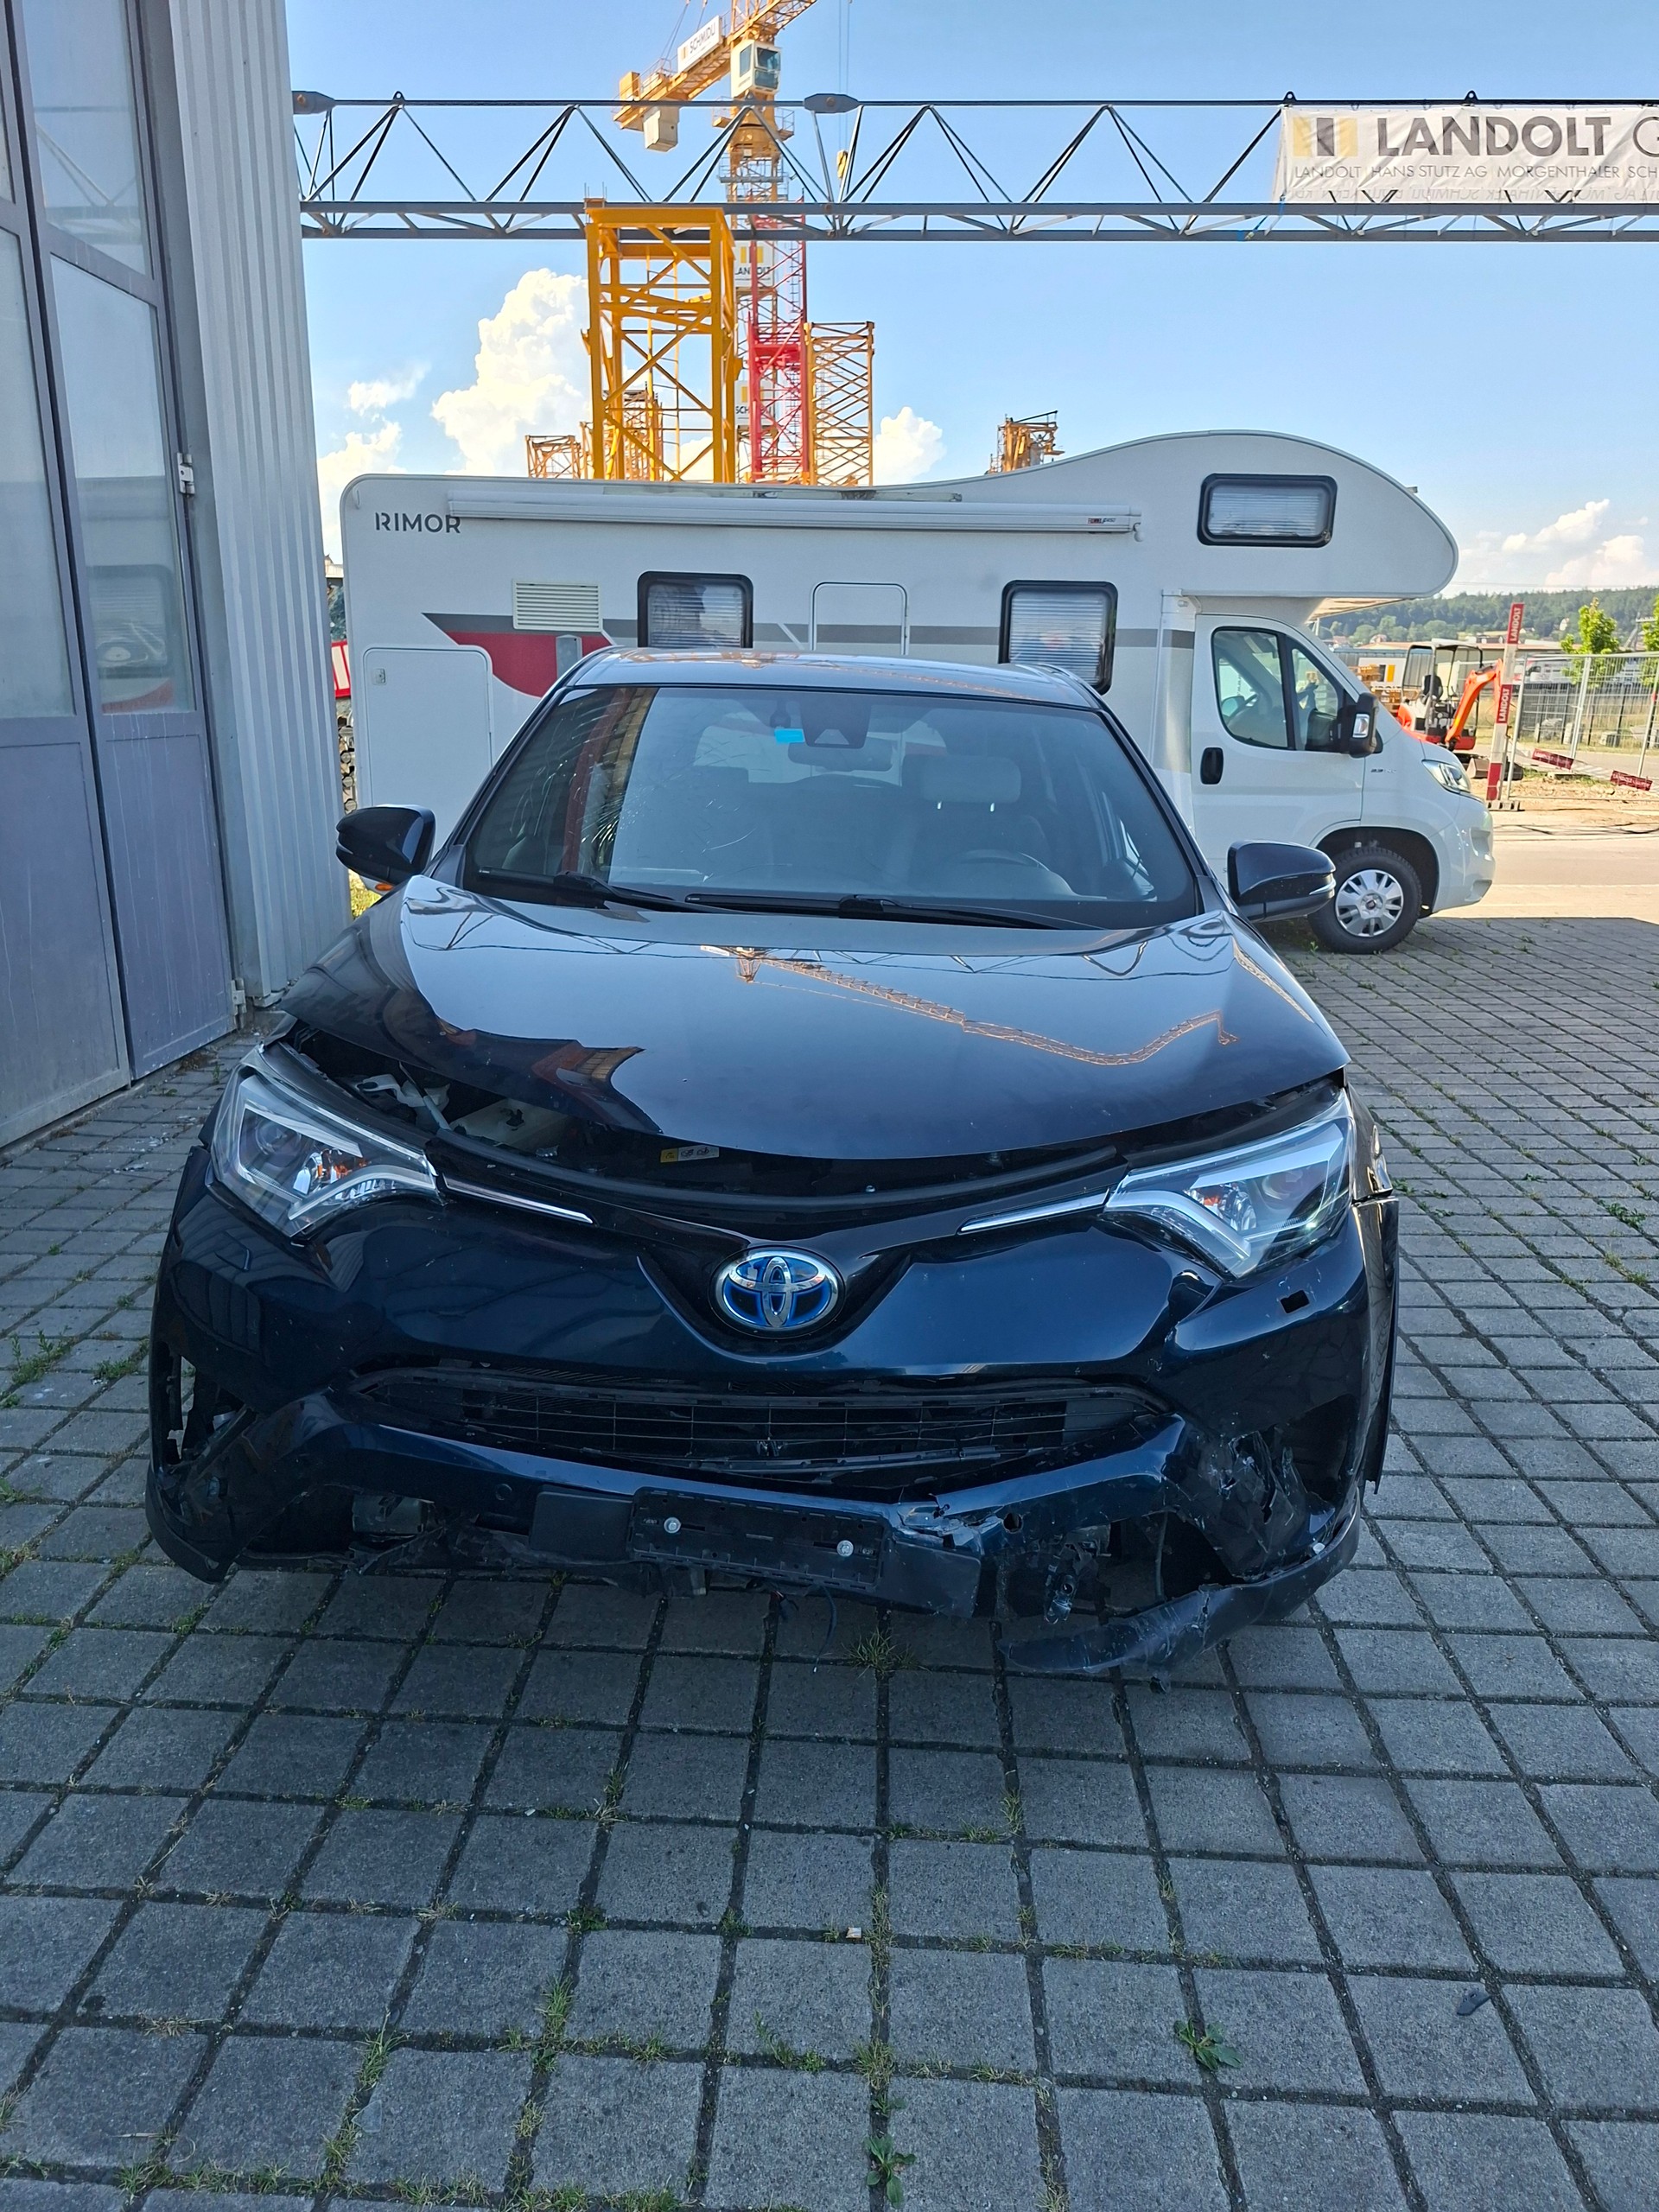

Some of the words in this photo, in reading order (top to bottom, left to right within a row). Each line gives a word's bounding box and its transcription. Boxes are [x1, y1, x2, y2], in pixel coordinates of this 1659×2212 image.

[1376, 115, 1611, 156] LANDOLT
[1294, 165, 1362, 178] LANDOLT
[1371, 165, 1414, 178] HANS
[1418, 165, 1460, 178] STUTZ
[1464, 165, 1487, 178] AG
[1497, 165, 1620, 178] MORGENTHALER
[375, 512, 461, 533] RIMOR
[1510, 607, 1522, 642] LANDOLT
[1498, 688, 1510, 721] LANDOLT
